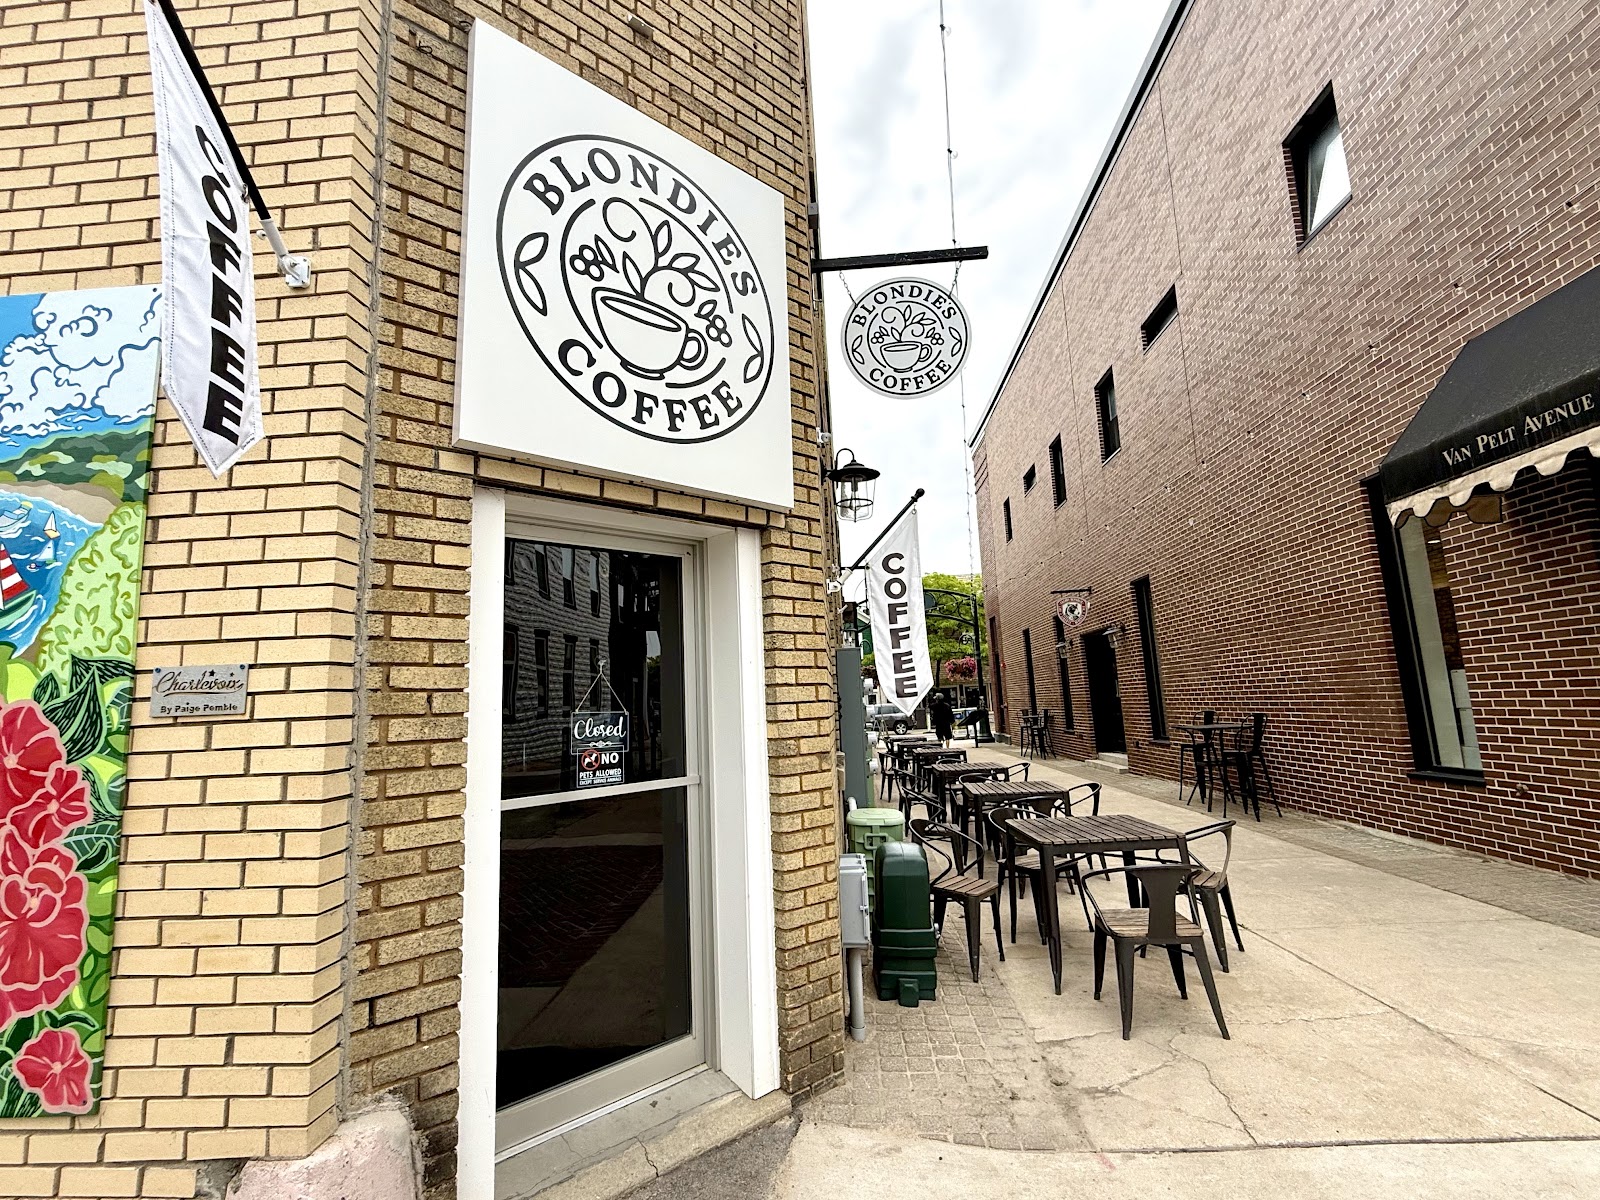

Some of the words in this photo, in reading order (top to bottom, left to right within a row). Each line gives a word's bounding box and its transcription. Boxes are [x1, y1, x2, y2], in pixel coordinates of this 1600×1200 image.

[523, 148, 758, 297] BLONDIES
[194, 124, 246, 446] COFFEE
[558, 338, 742, 432] COFFEE
[869, 360, 952, 391] COFFEE
[1442, 445, 1471, 466] VAN
[1476, 426, 1516, 454] PELT
[1524, 393, 1595, 435] AVENUE
[881, 552, 918, 699] COFFEE
[154, 670, 243, 693] Charlevoix
[160, 705, 172, 714] By
[175, 702, 200, 713] Paige
[203, 703, 238, 712] Pemble
[574, 716, 626, 740] Closed
[595, 768, 621, 776] ALLOWED
[601, 752, 619, 764] NO
